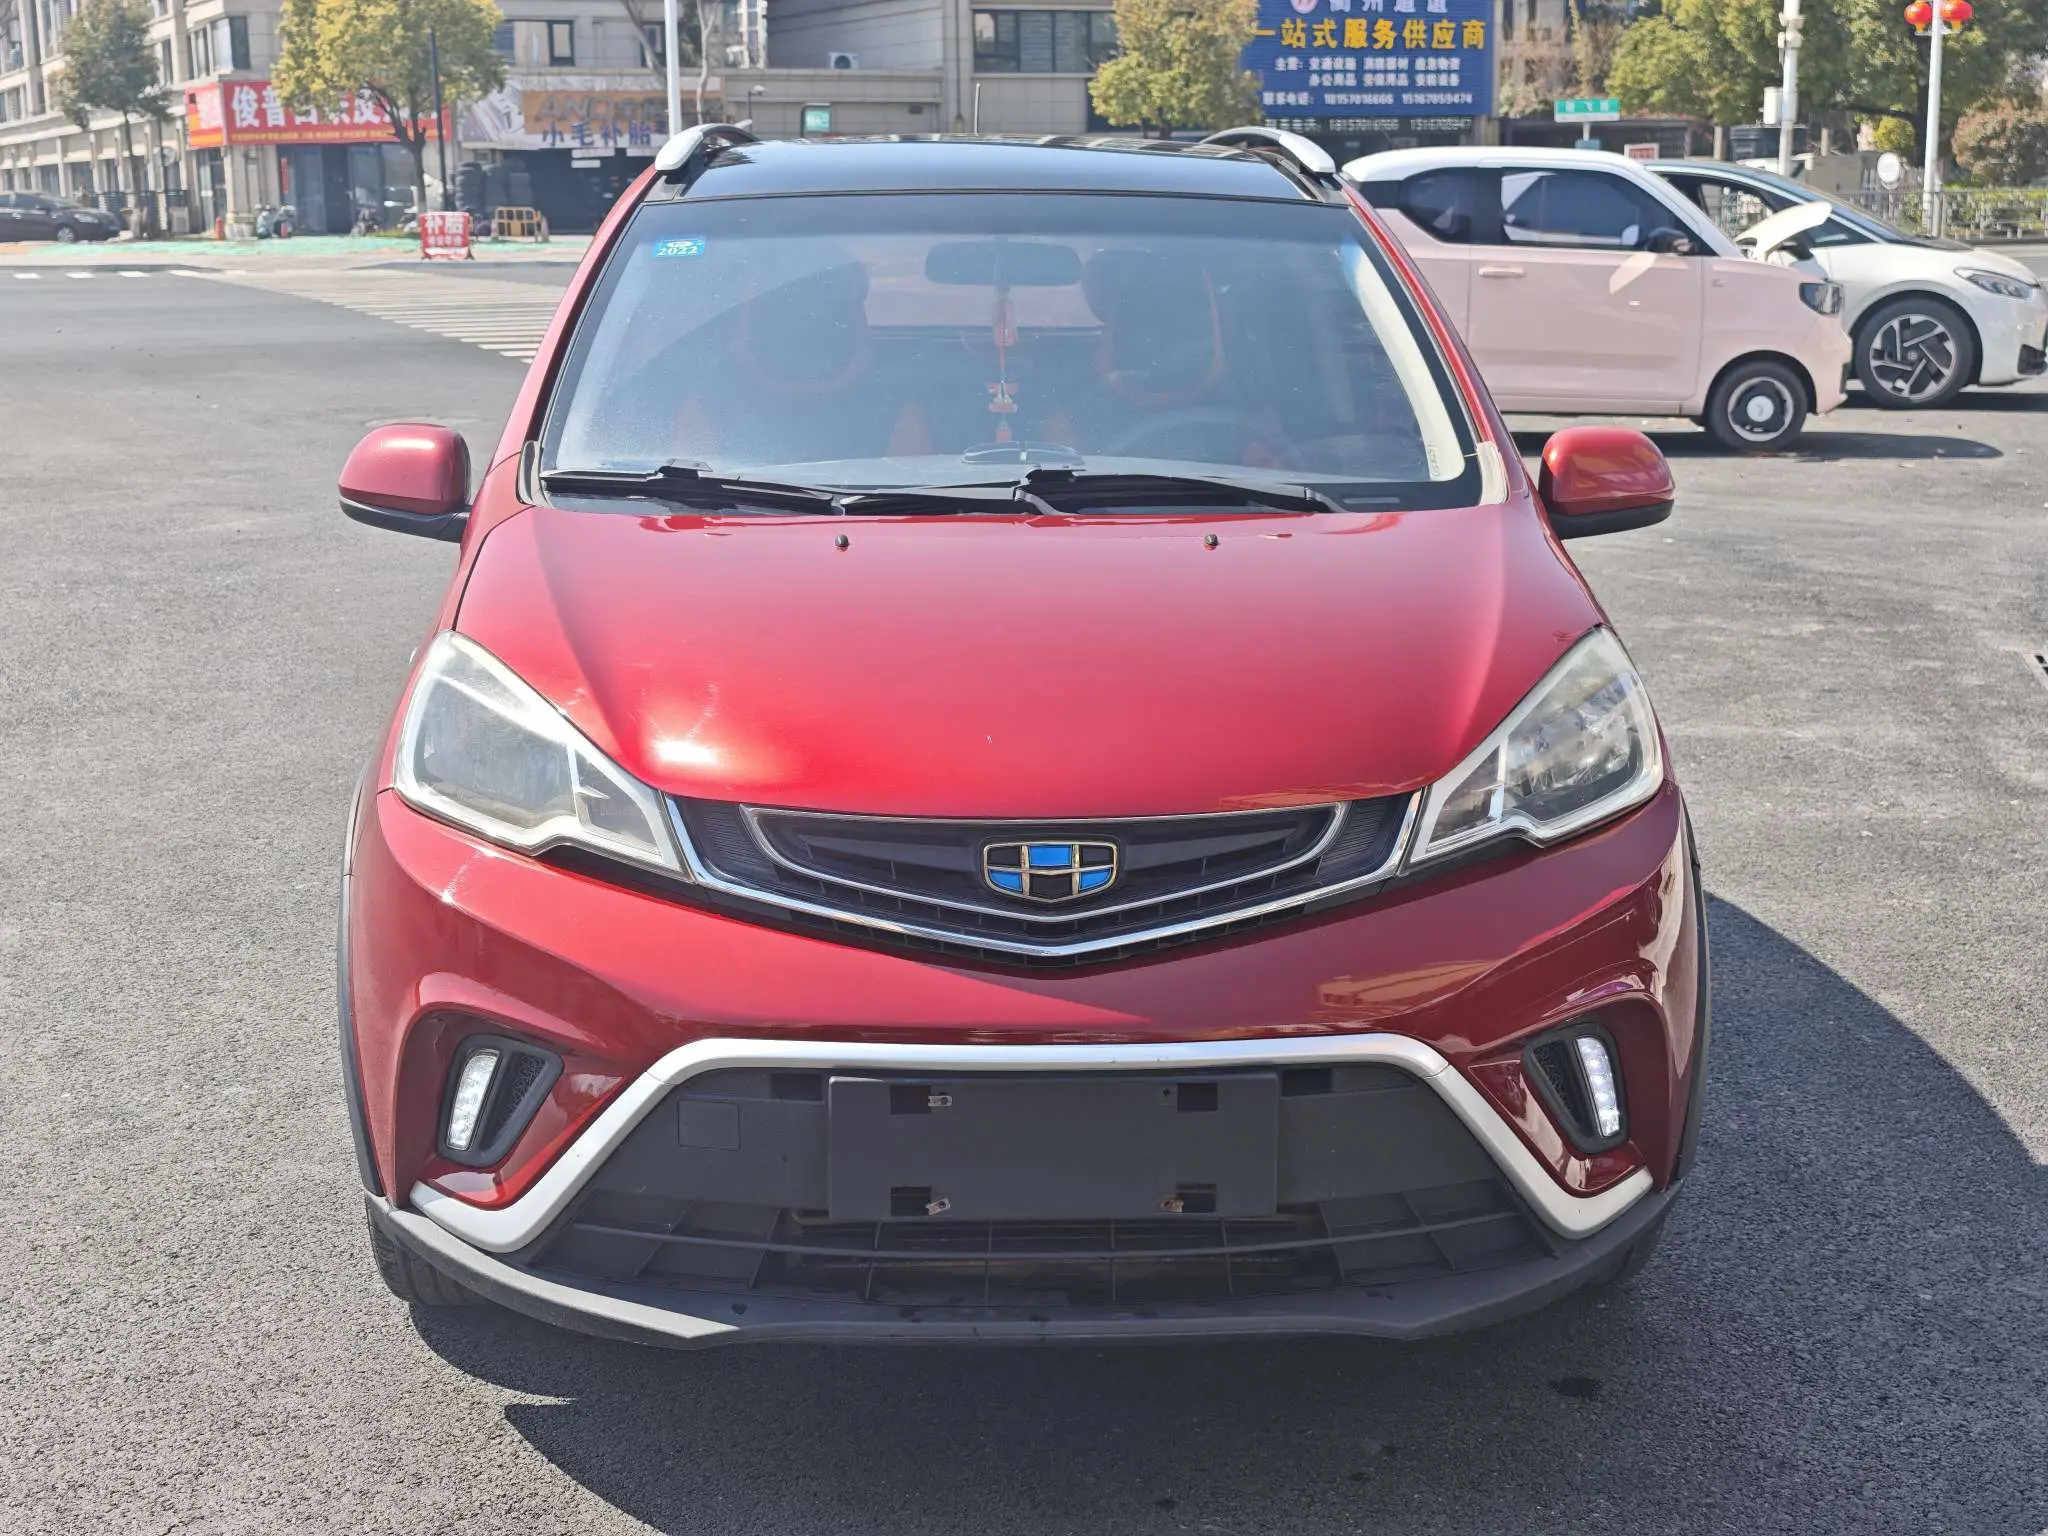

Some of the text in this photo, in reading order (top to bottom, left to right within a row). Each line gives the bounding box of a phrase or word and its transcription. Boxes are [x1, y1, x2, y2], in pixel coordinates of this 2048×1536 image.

[1255, 18, 1486, 49] 一站式服务供应商
[657, 246, 698, 256] 2022
